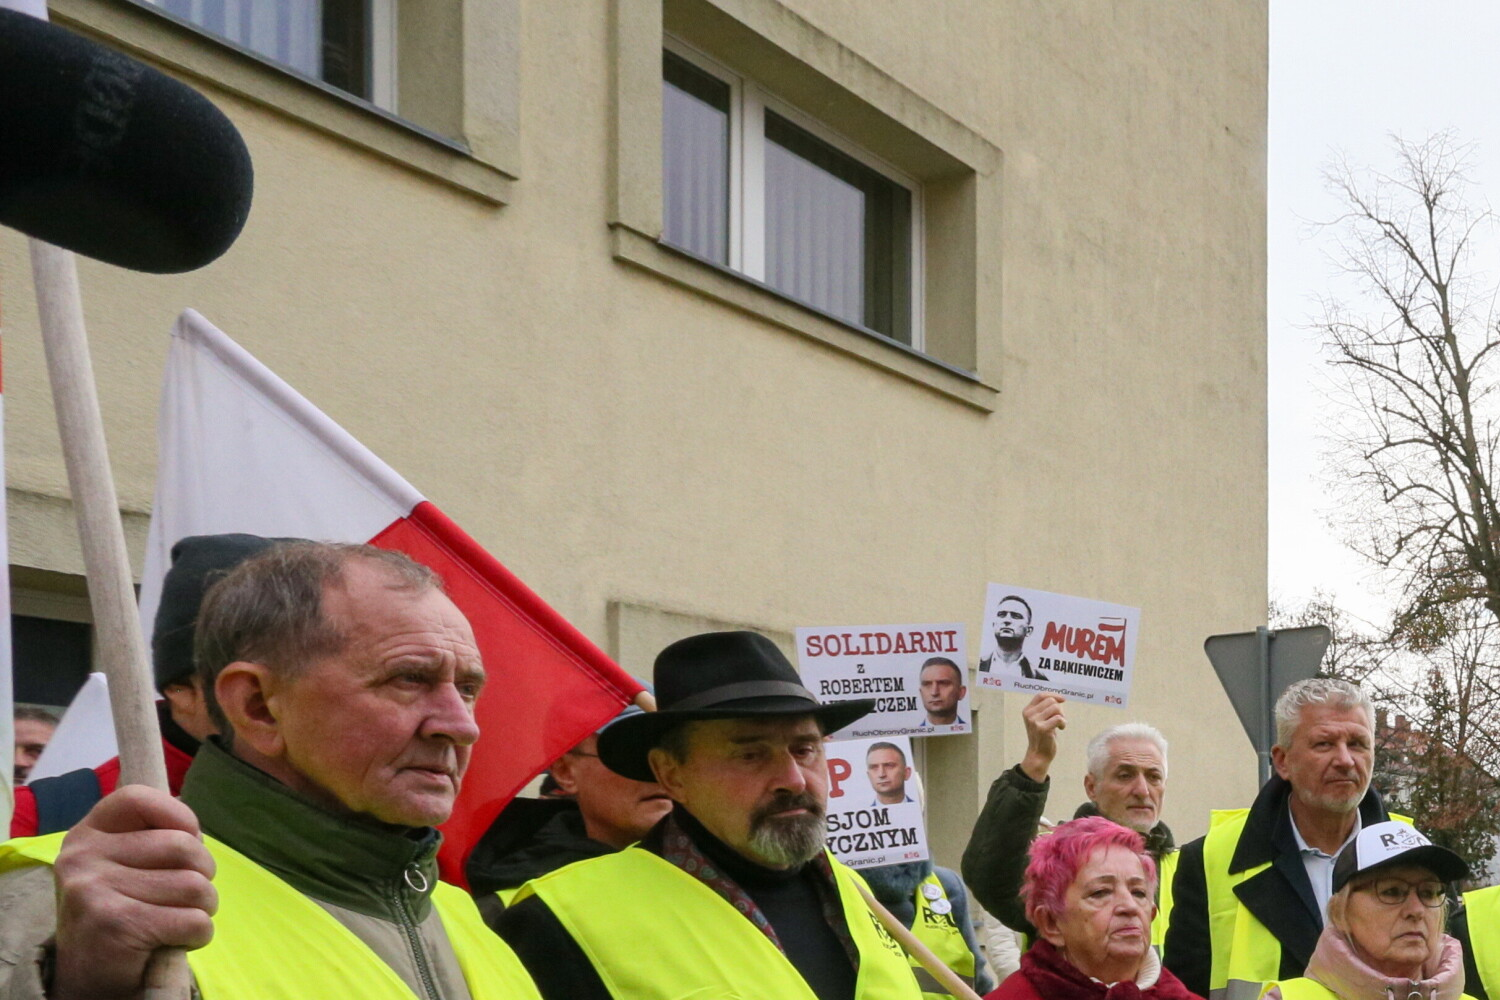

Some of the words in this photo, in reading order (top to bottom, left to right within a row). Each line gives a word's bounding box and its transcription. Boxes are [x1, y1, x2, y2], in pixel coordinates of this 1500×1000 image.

[806, 630, 958, 657] SOLIDARNI
[1041, 620, 1126, 667] MUREM
[1038, 657, 1051, 670] ZA
[1053, 659, 1124, 682] BĄKIEWICZEM
[820, 677, 905, 696] ROBERTEM
[826, 827, 918, 855] YCZNYM
